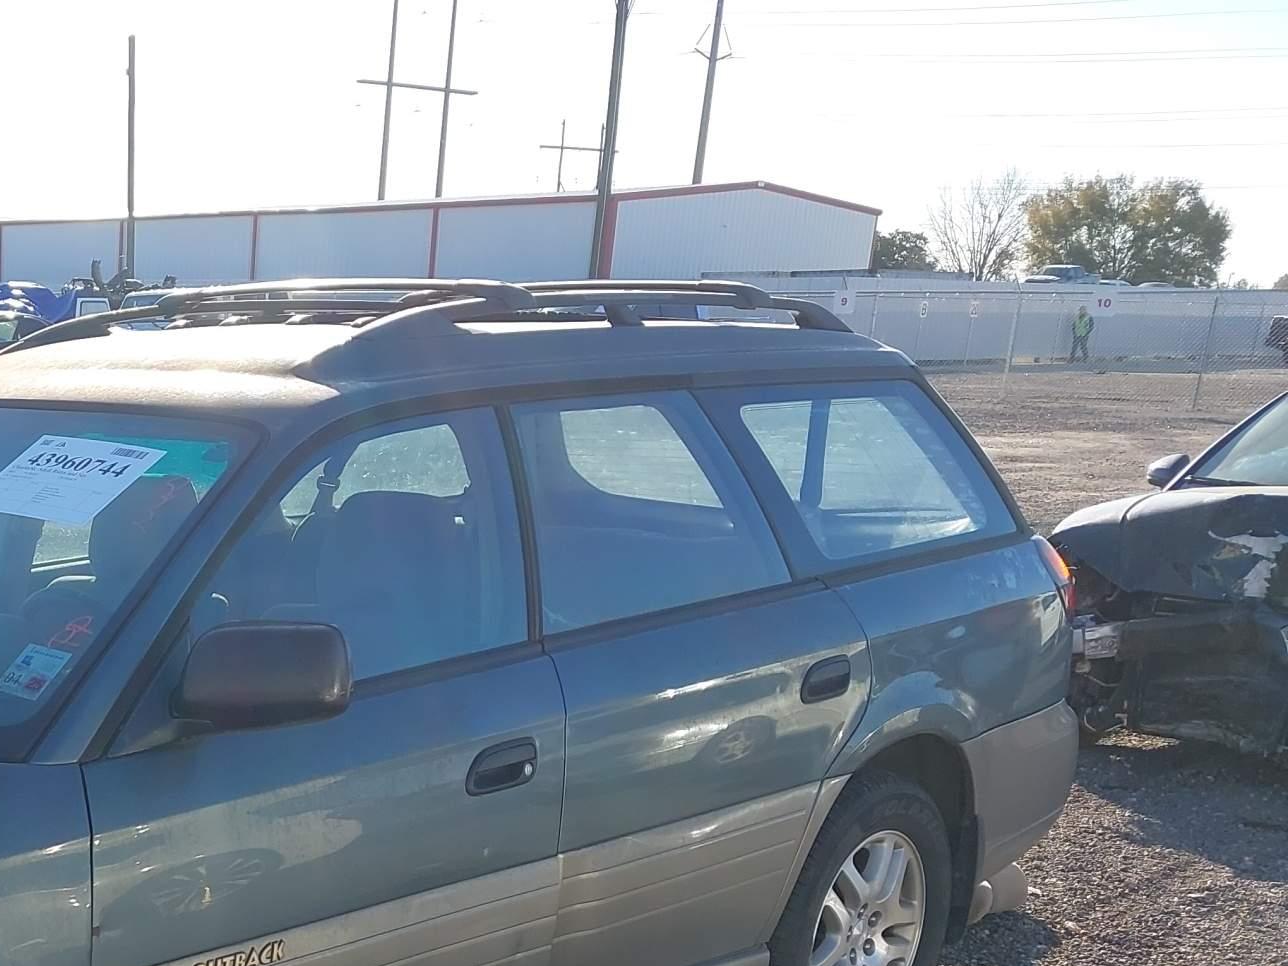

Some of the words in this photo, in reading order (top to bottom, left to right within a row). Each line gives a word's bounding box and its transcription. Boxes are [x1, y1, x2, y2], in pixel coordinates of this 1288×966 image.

[840, 297, 849, 306] 9
[1097, 298, 1113, 308] 10
[27, 451, 133, 478] 43960744
